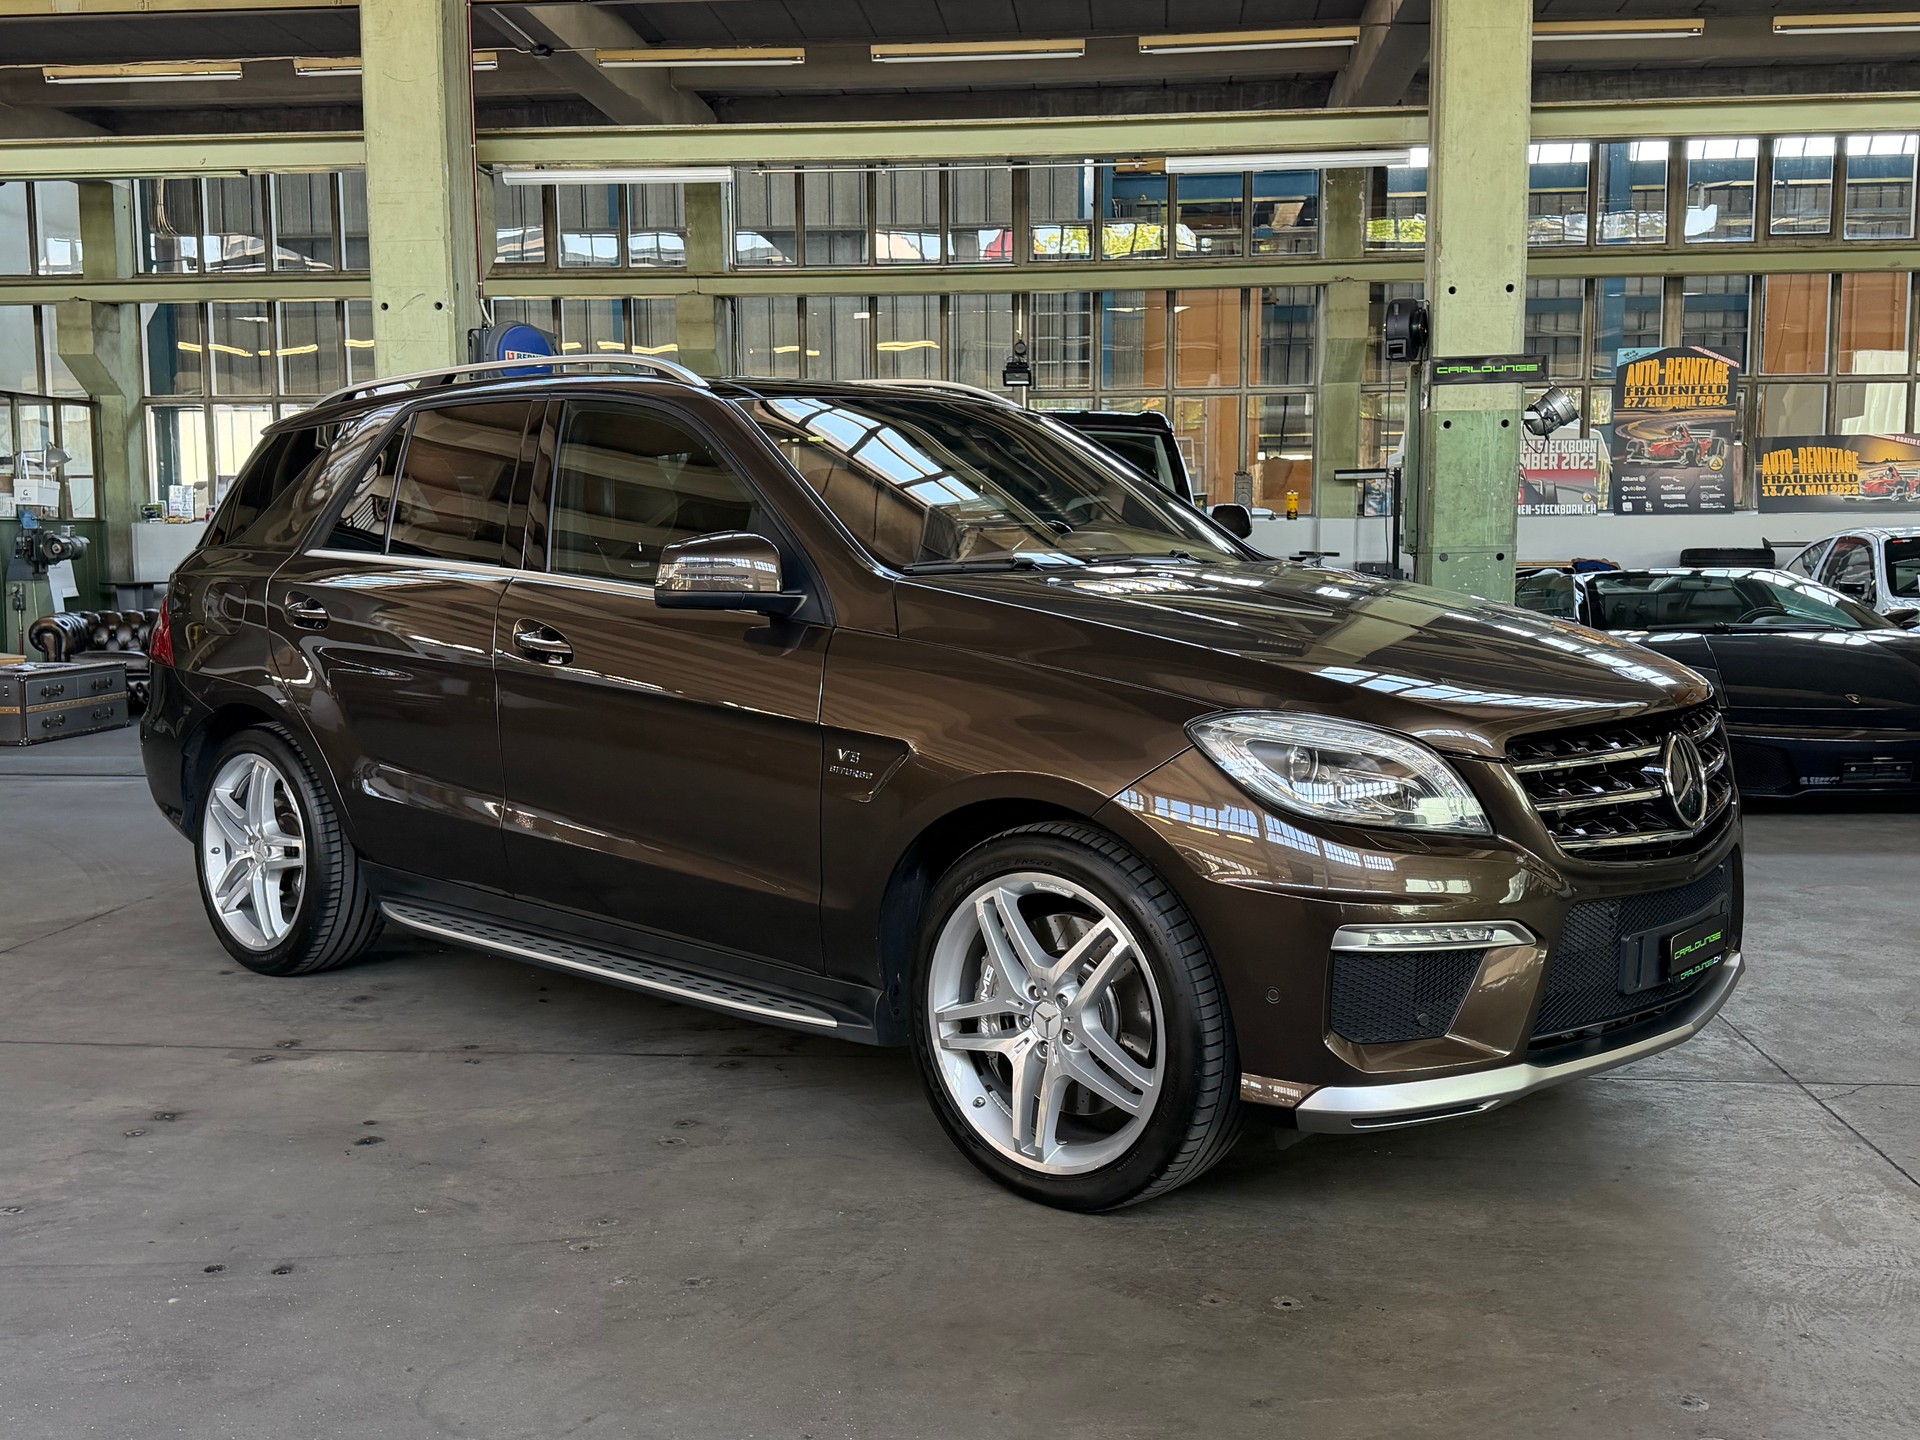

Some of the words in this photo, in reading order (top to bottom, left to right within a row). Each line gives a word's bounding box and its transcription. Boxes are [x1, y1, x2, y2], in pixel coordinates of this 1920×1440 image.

[1436, 364, 1538, 374] CARLOUNGE
[1625, 357, 1730, 386] AUTO-RENNTAGE
[1625, 385, 1728, 397] FRAUENFELD
[1698, 395, 1727, 407] 2024
[1536, 439, 1597, 454] STECKBORN
[1561, 453, 1597, 470] 2023
[1762, 447, 1860, 475] AUTO-RENNTAGE
[1763, 474, 1858, 484] FRAUENFELD
[1830, 484, 1860, 495] 2023
[837, 748, 861, 764] V8
[1674, 931, 1722, 960] CARLOUNGE
